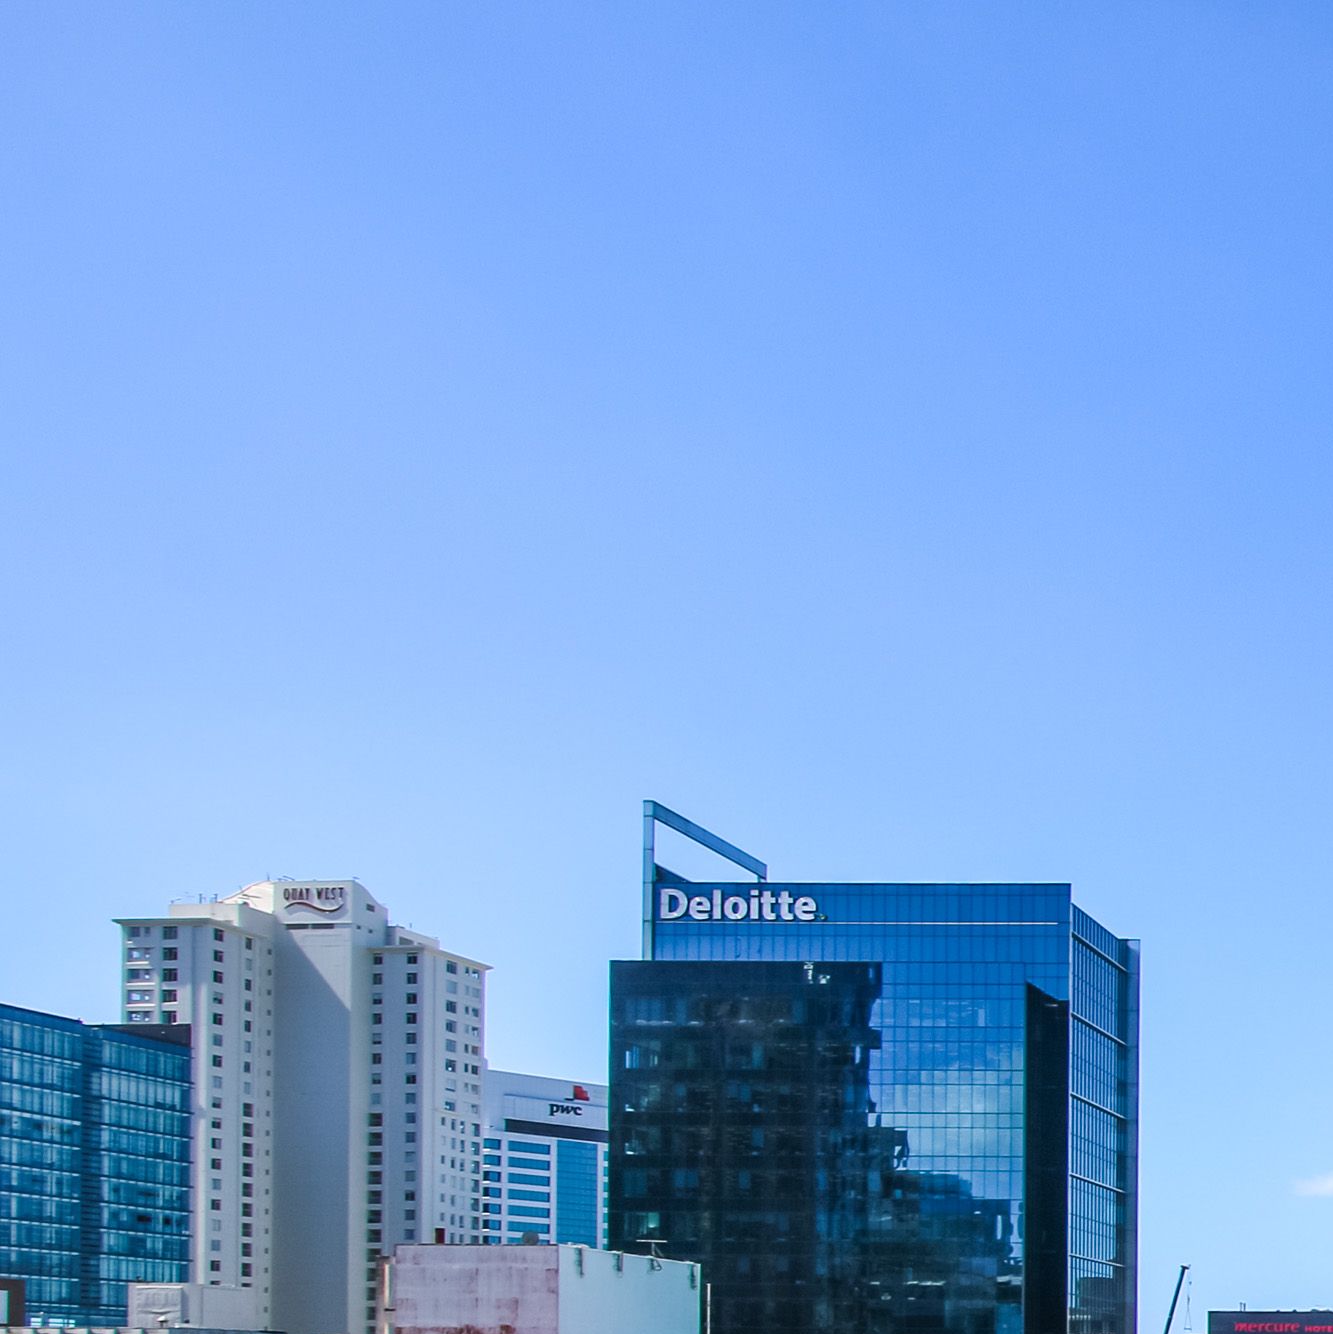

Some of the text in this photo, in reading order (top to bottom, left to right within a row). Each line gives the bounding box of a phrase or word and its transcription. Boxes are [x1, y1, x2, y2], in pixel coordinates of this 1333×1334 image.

[283, 887, 344, 901] QUAY WEST
[548, 1103, 583, 1117] pwc
